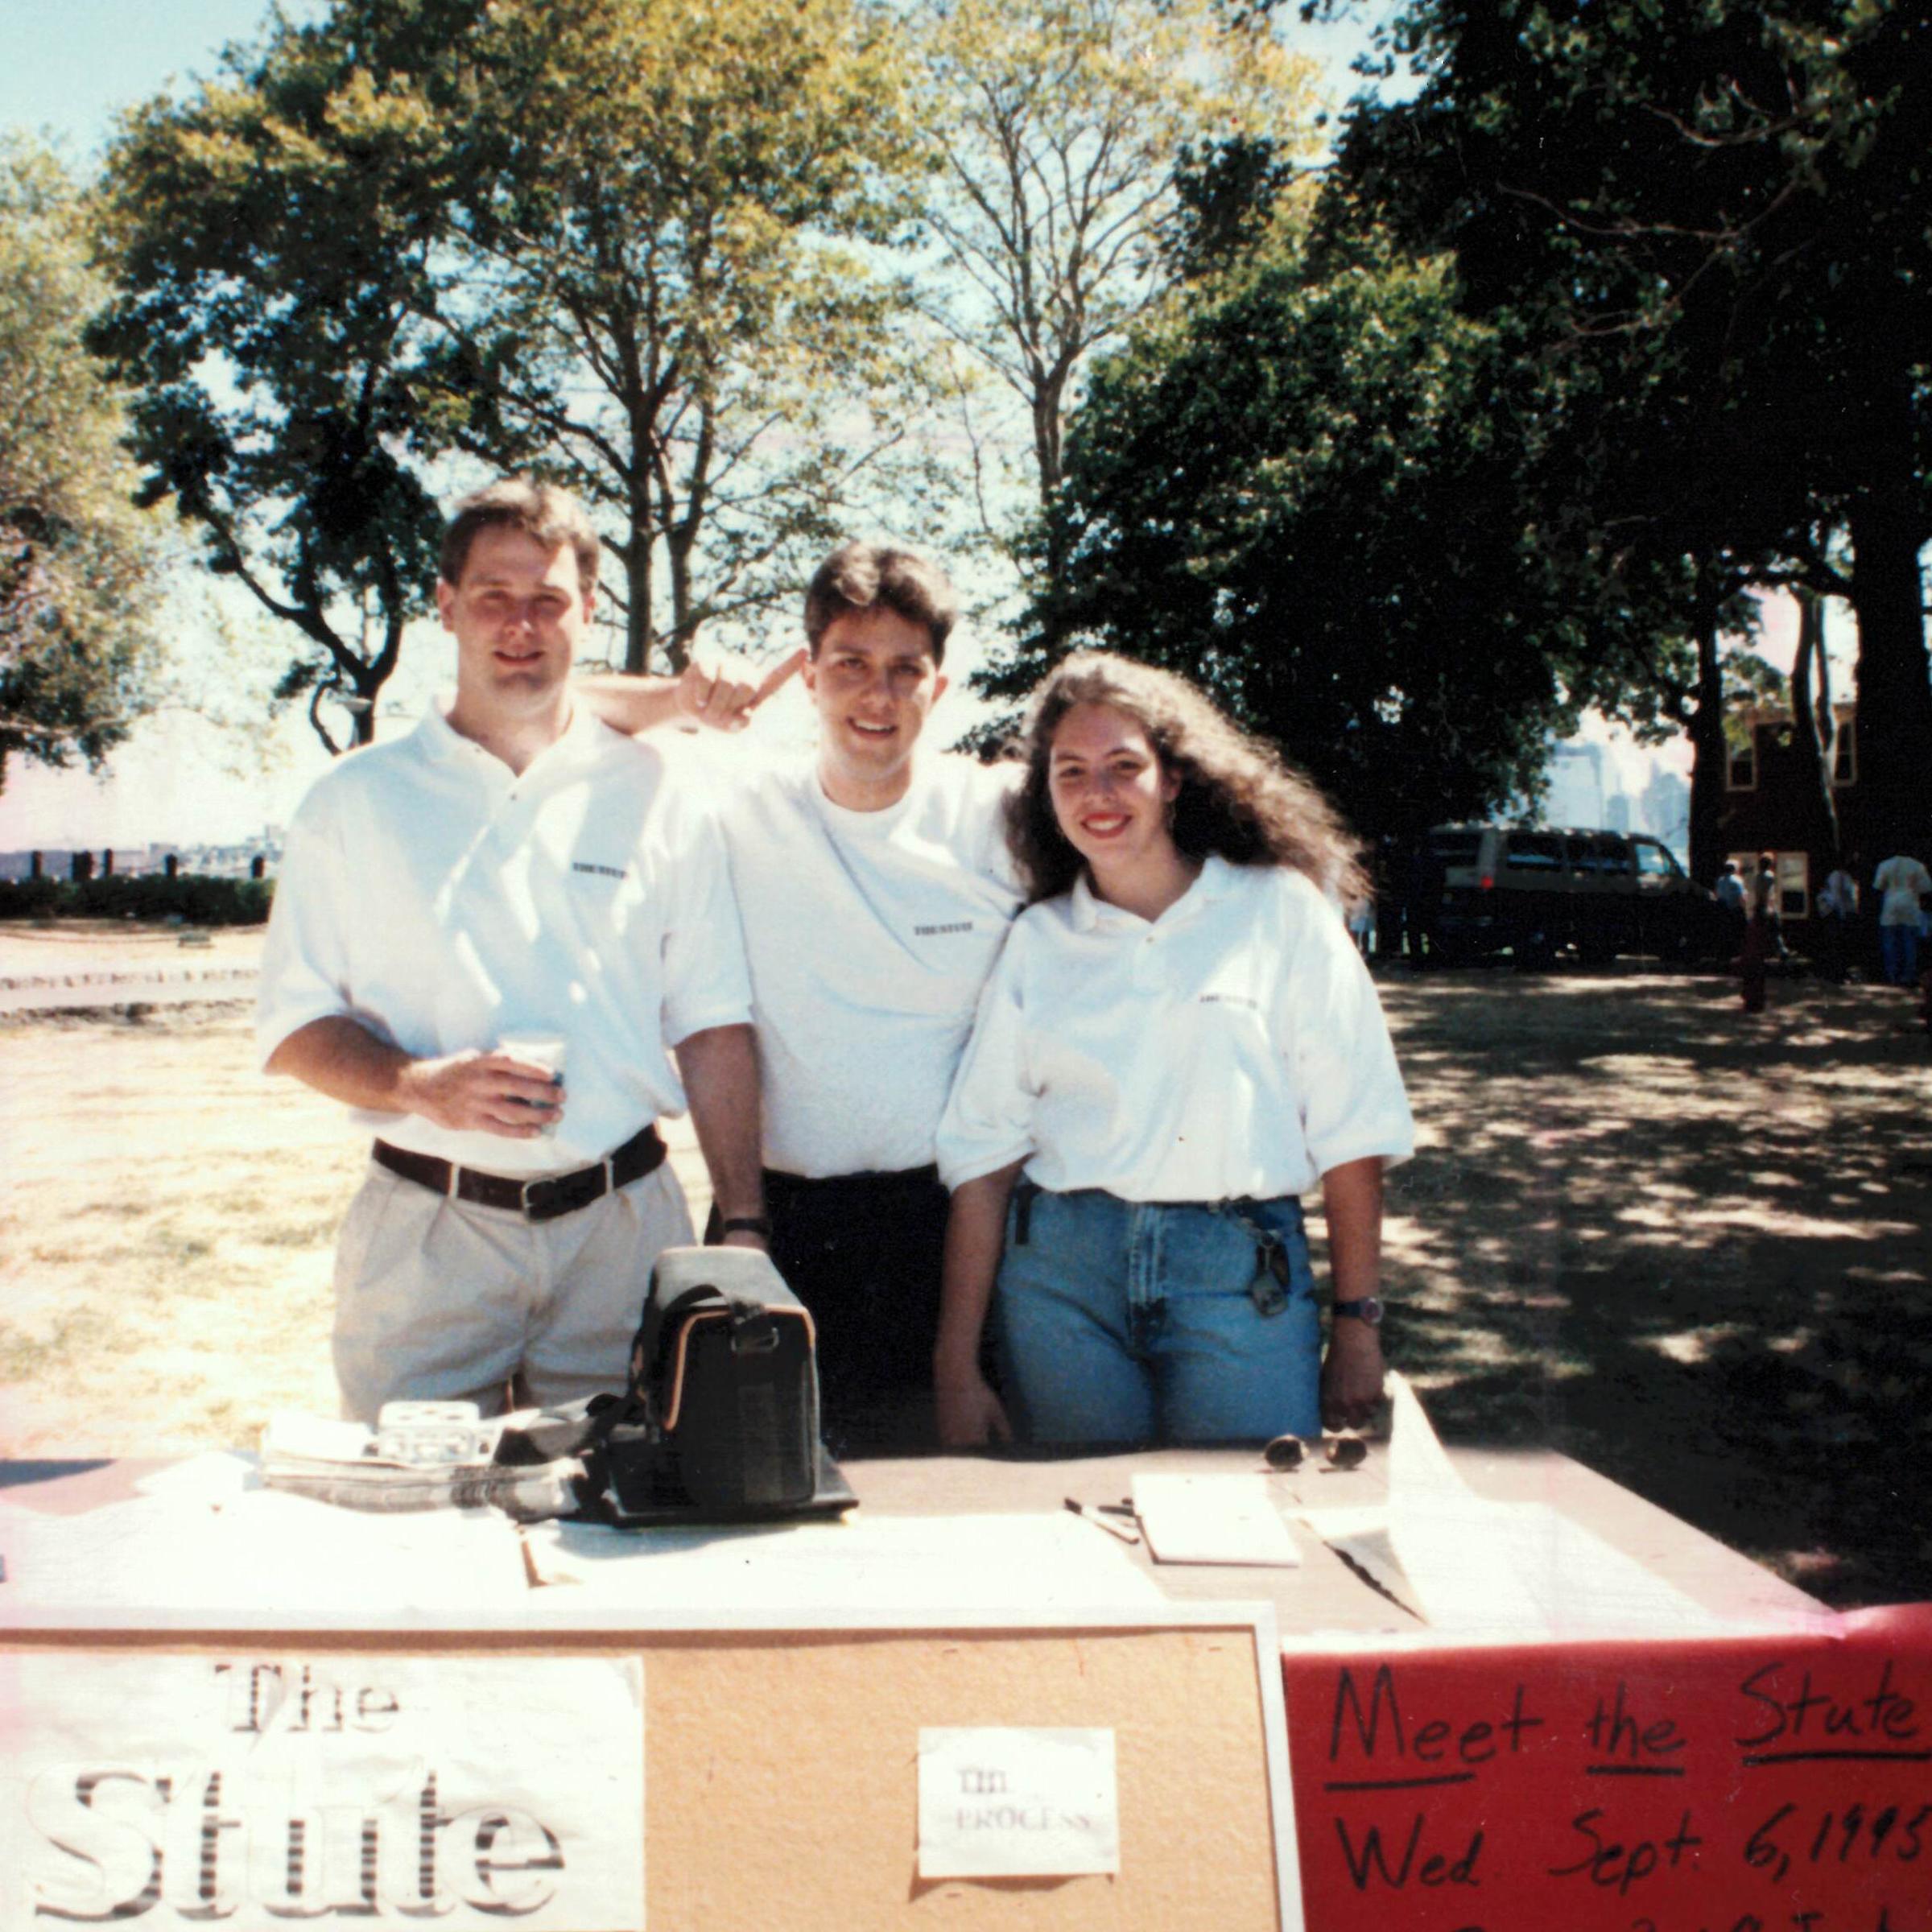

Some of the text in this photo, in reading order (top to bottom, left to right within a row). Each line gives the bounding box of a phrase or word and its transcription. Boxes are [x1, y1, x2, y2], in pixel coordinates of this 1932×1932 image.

[214, 1664, 401, 1733] The
[1329, 1660, 1919, 1763] Meet the Stute
[27, 1771, 567, 1922] Stute
